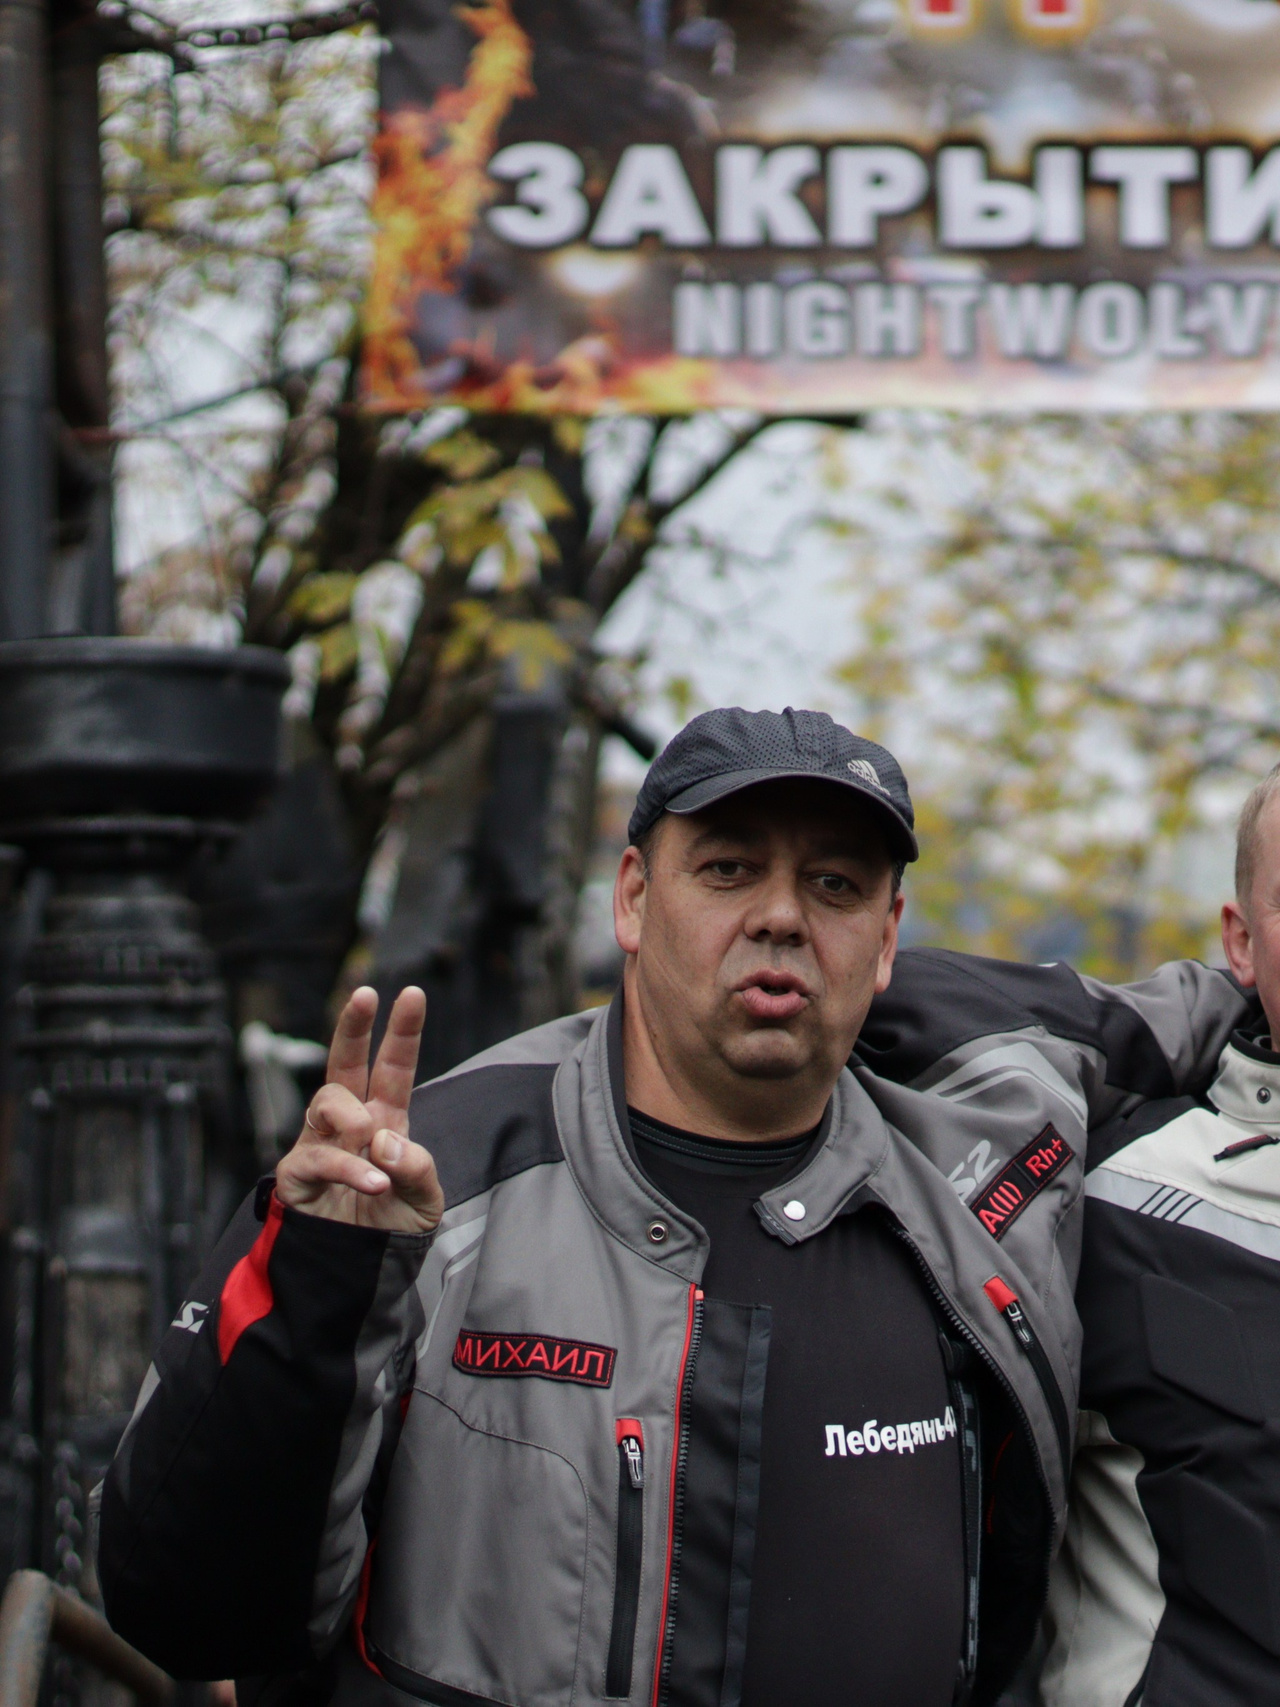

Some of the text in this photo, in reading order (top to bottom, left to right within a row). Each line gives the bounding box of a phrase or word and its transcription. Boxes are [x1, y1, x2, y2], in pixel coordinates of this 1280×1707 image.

[1025, 1138, 1063, 1178] Rh+
[456, 1335, 606, 1379] МИХАИЛ
[824, 1405, 958, 1457] Лебедянь4
